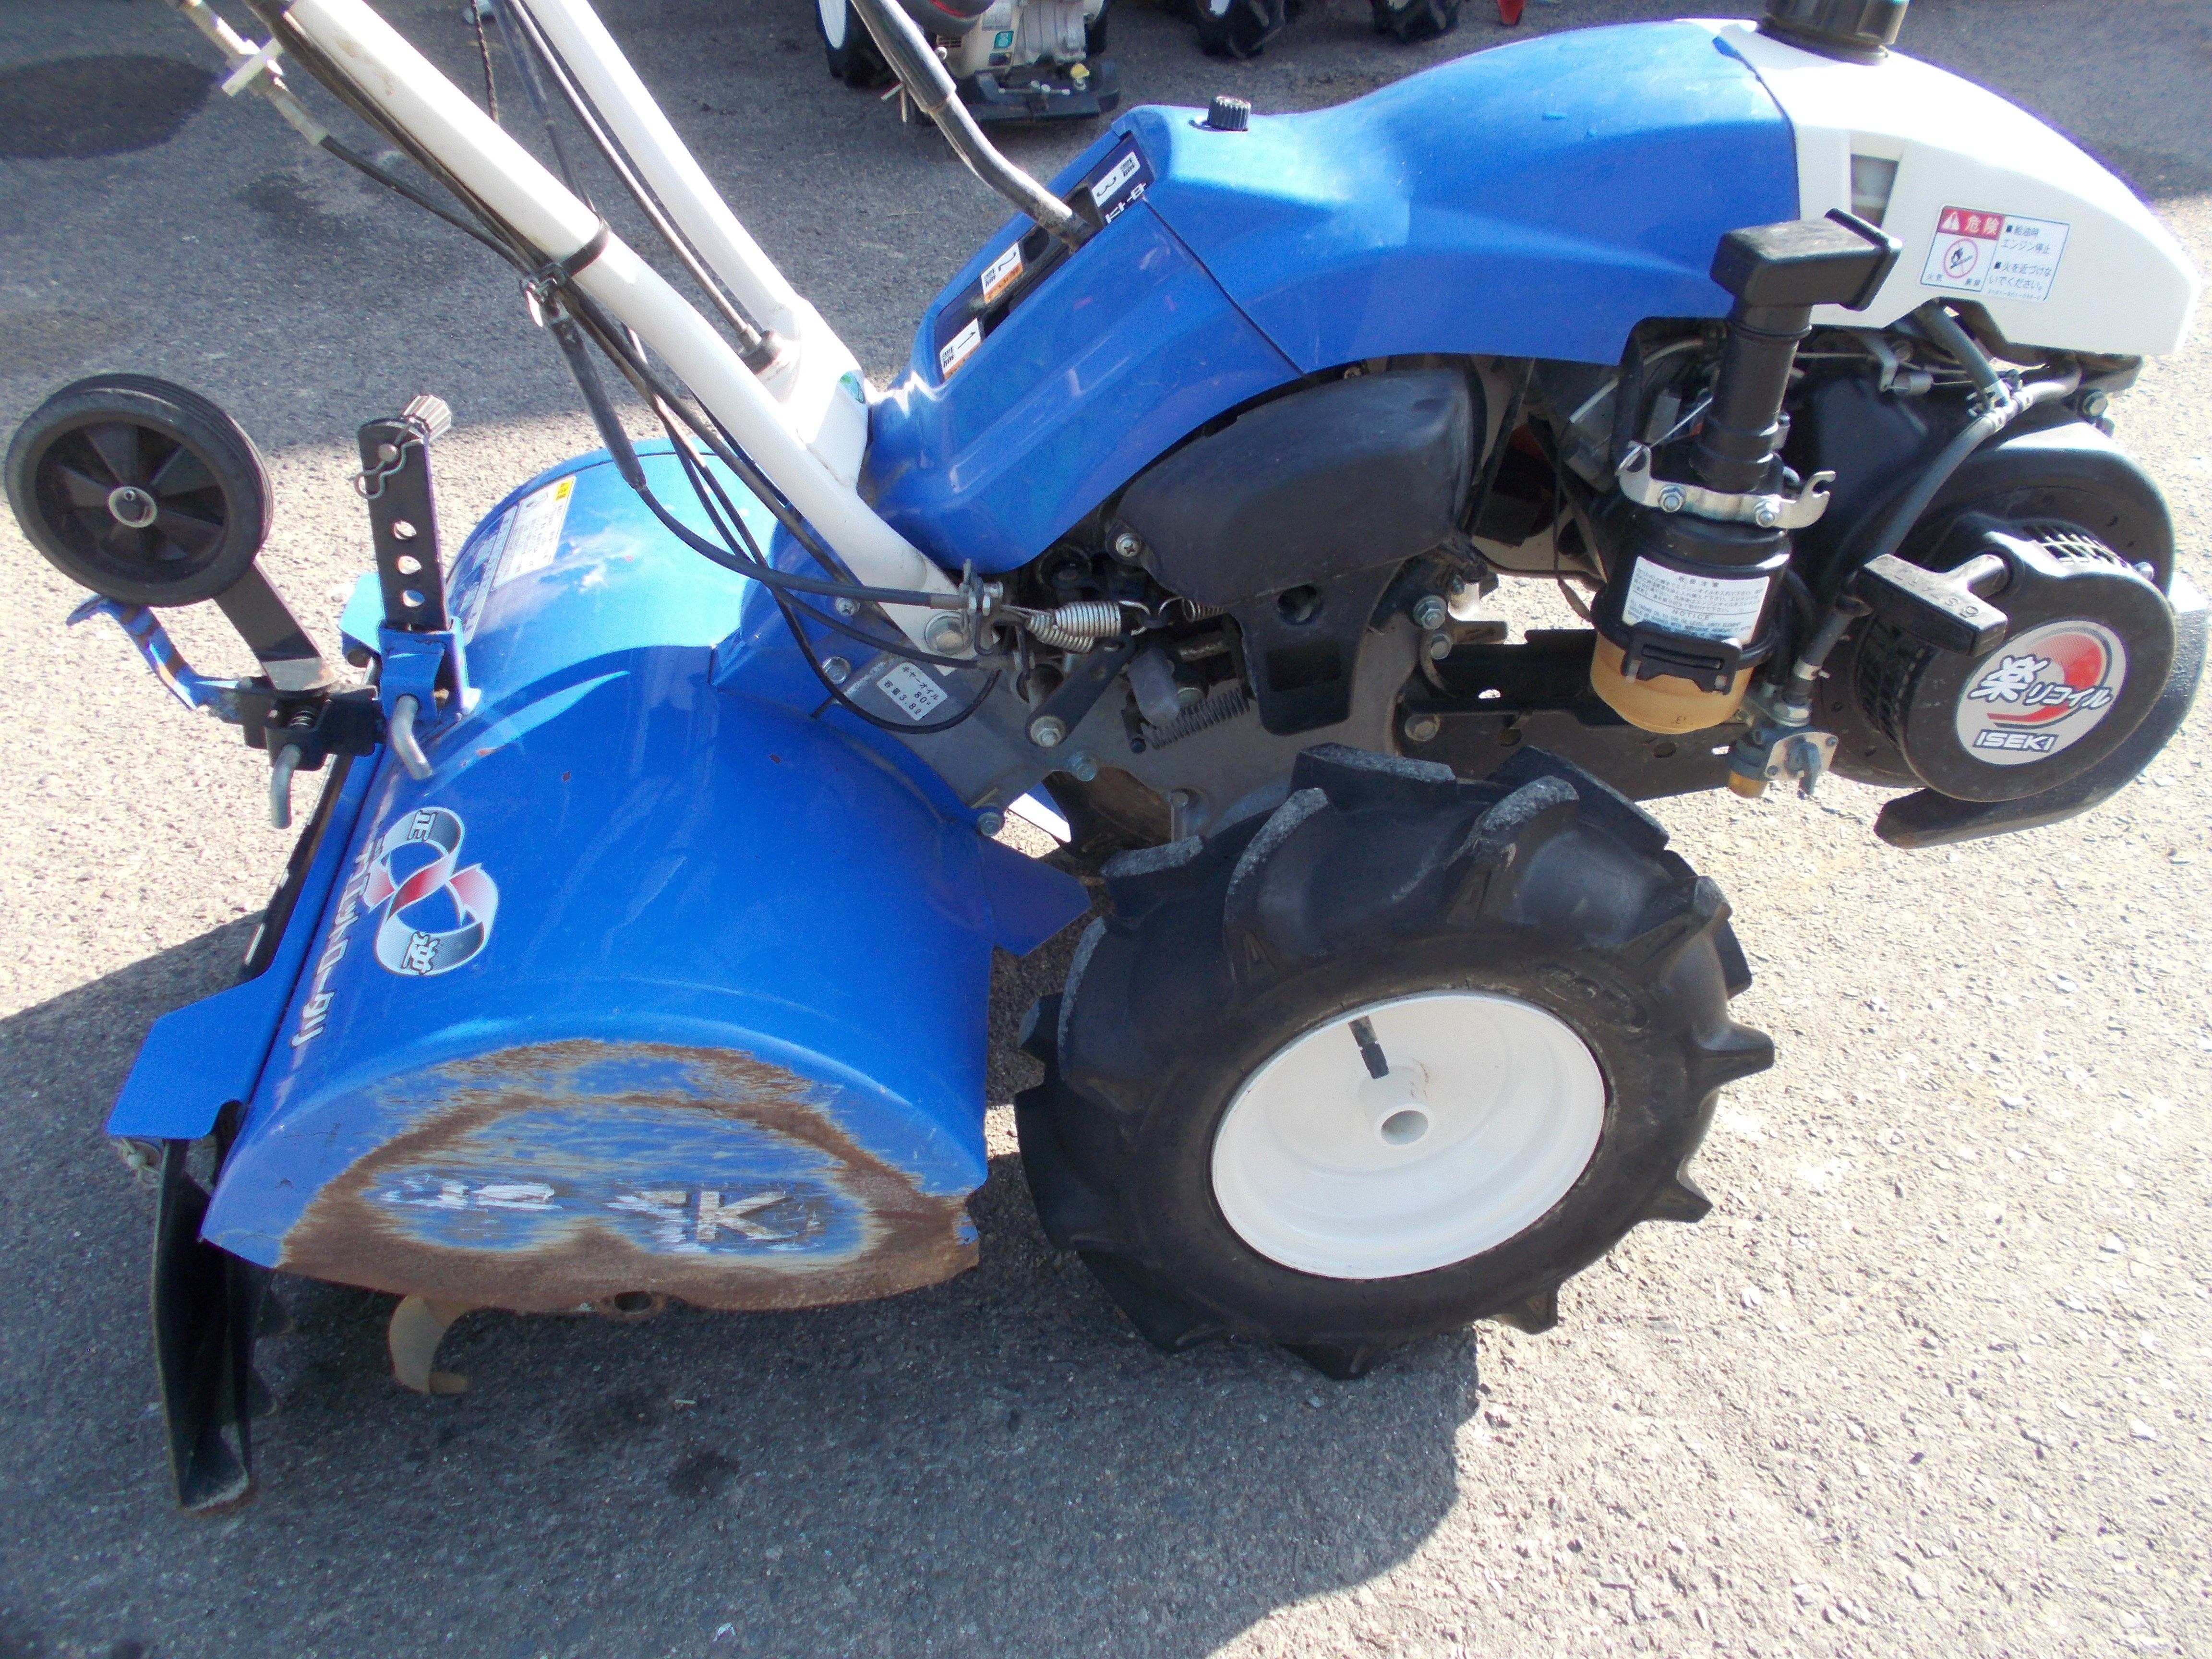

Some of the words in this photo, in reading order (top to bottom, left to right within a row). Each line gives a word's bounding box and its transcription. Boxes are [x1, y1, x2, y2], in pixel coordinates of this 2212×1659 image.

[1096, 176, 1117, 197] 3
[1965, 215, 2000, 235] 危険
[2001, 239, 2050, 254] エンジン停止
[998, 251, 1017, 272] 2
[957, 331, 976, 349] 1
[1672, 609, 1710, 620] NOTICE
[1976, 731, 2055, 750] ISEKI
[407, 810, 436, 841] 正
[401, 931, 441, 975] 逆
